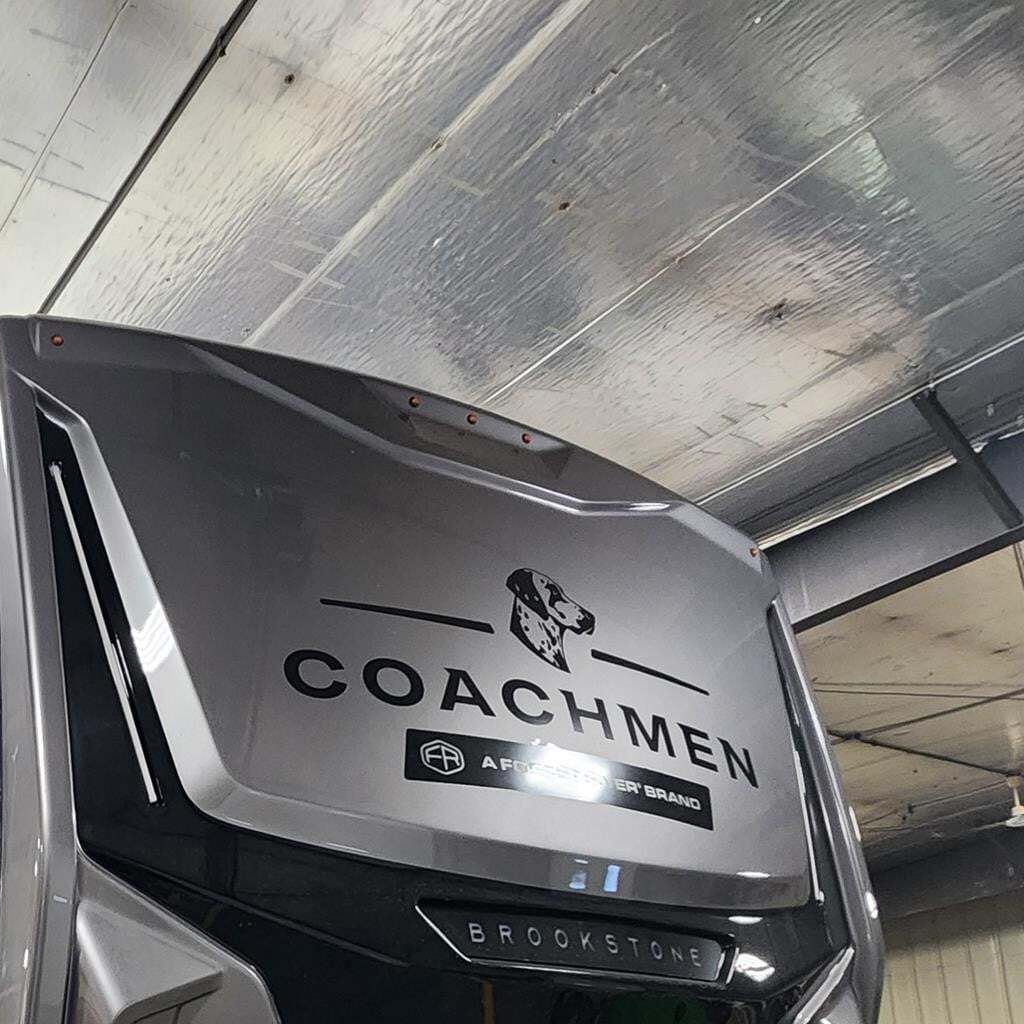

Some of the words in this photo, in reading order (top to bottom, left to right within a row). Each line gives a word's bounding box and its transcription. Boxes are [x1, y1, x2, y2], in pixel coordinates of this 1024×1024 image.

[283, 649, 759, 789] COACHMEN
[482, 756, 497, 770] A
[644, 785, 701, 810] BRAND
[468, 922, 702, 967] BROOKSTONE
